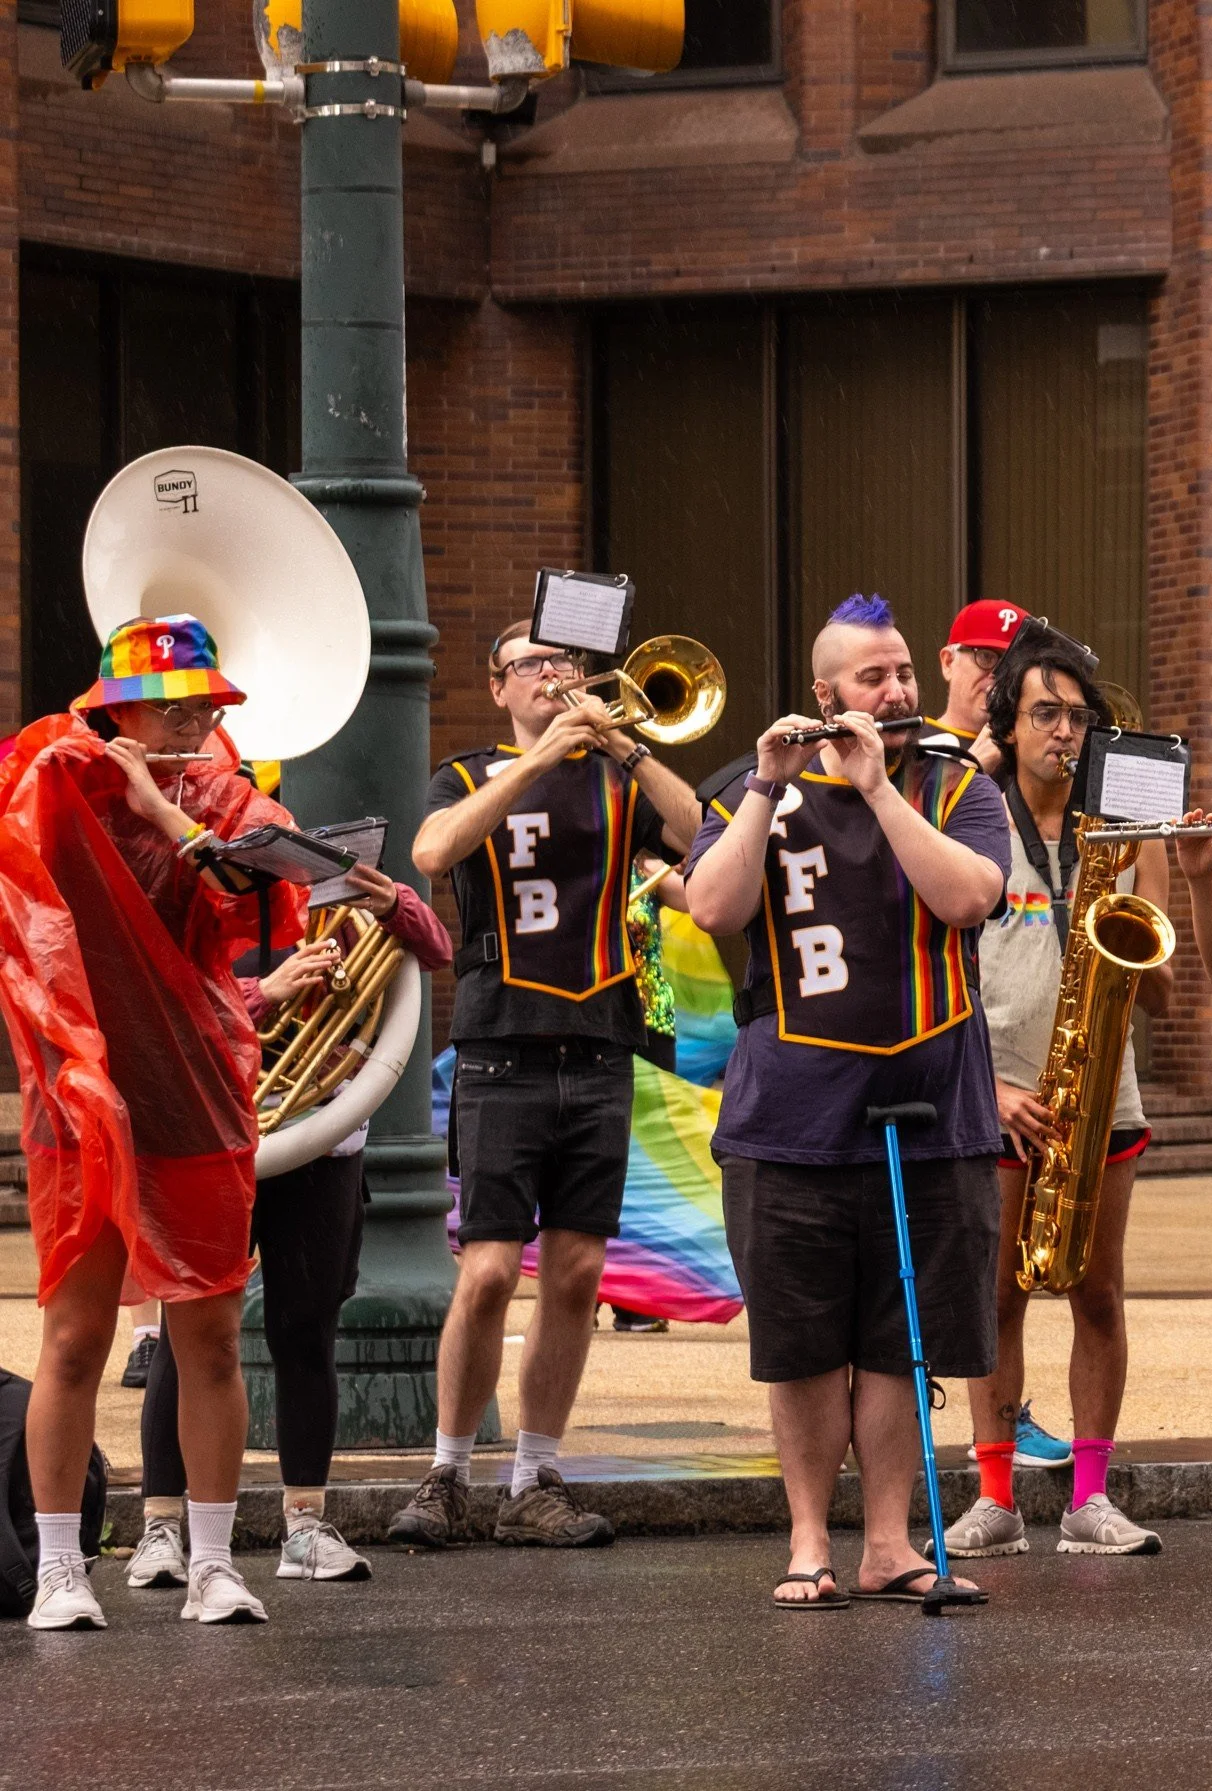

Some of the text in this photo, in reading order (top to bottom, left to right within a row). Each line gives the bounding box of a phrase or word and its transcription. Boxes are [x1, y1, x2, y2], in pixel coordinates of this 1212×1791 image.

[157, 480, 193, 493] BUNDY
[998, 608, 1018, 633] P
[156, 634, 175, 660] P
